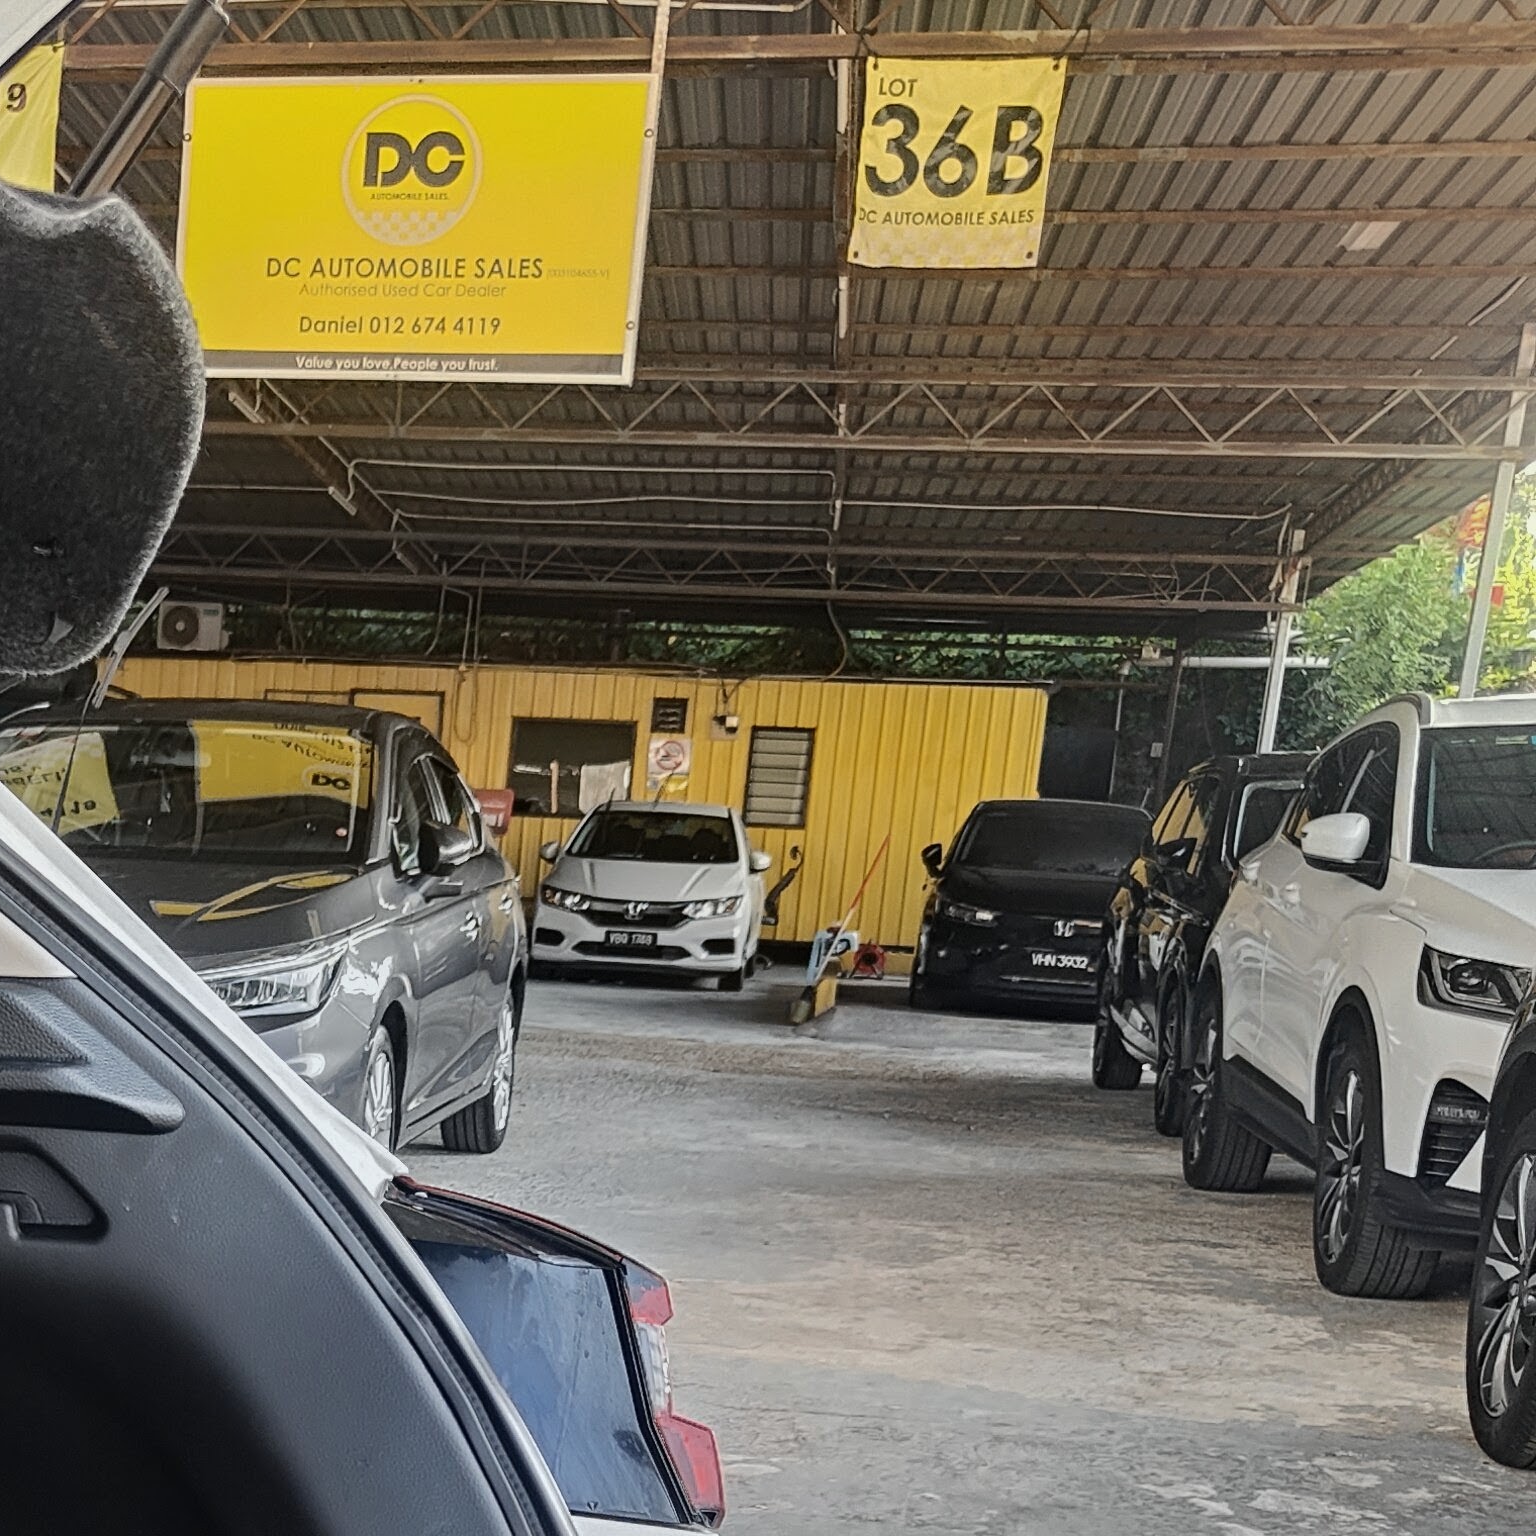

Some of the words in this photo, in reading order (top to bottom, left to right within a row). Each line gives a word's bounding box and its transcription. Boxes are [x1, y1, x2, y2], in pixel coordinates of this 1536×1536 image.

[878, 77, 917, 97] LOT
[363, 131, 465, 187] DC
[864, 103, 1044, 198] 36B
[858, 207, 877, 224] DC
[882, 210, 984, 225] AUTOMOBILE
[989, 209, 1035, 225] SALES
[266, 258, 301, 278] DC
[310, 258, 466, 279] AUTOMOBILE
[474, 258, 543, 279] SALES
[299, 283, 377, 297] Authorised
[382, 284, 418, 297] Used
[423, 284, 452, 297] Car
[455, 284, 506, 297] Dealer
[299, 316, 363, 333] Daniel
[369, 317, 405, 334] 012
[411, 317, 446, 334] 674
[453, 317, 501, 335] 4119
[296, 356, 333, 369] Value
[335, 358, 359, 371] you
[441, 360, 465, 372] you
[1032, 953, 1056, 966] VHN
[1057, 954, 1088, 969] 3932
